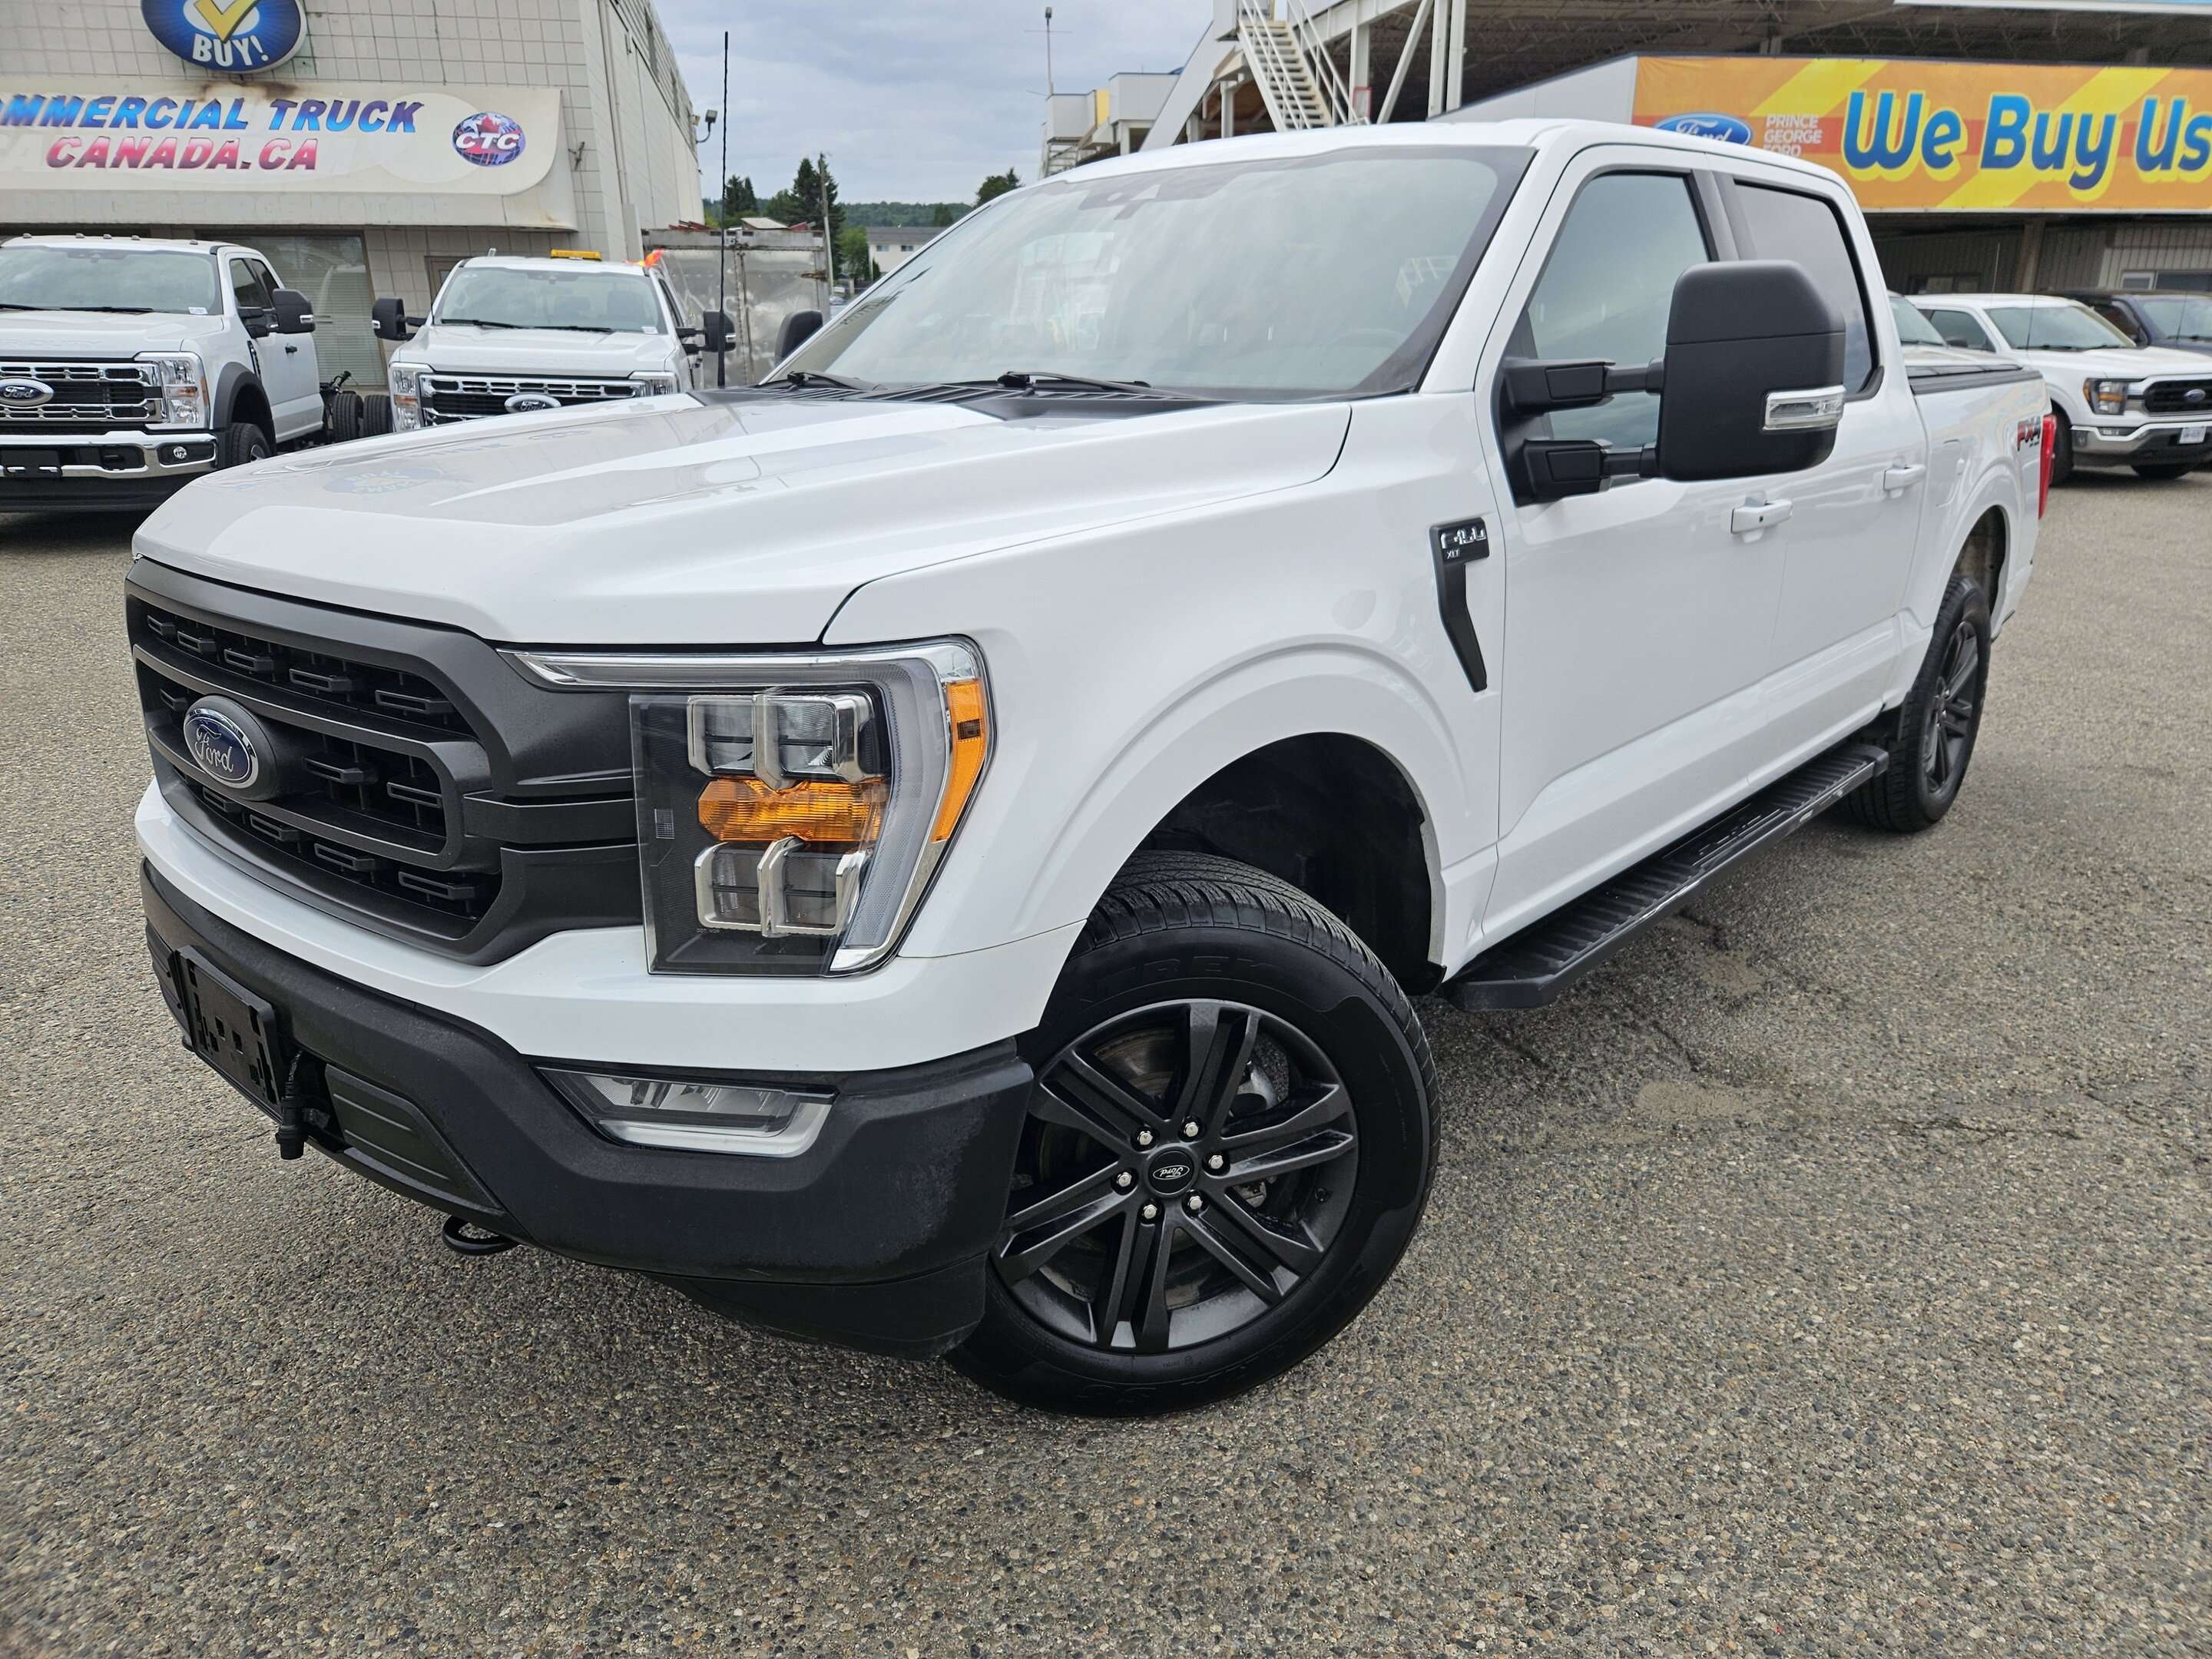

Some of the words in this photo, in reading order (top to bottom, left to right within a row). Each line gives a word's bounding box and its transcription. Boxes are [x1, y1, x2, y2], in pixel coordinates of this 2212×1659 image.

[193, 33, 268, 67] BUY!
[0, 93, 248, 131] MMERCIAL
[268, 98, 424, 132] TRUCK
[1765, 115, 1820, 129] PRINCE
[455, 132, 520, 151] CTC
[1763, 128, 1823, 144] GEORGE
[1843, 91, 1963, 171] We
[1979, 94, 2118, 190] Buy
[2135, 98, 2212, 172] Us
[46, 135, 318, 170] CANADA.CA
[3, 386, 34, 399] Ford
[1445, 548, 1460, 560] XLT
[195, 724, 233, 773] Ford
[1160, 1166, 1184, 1178] Ford
